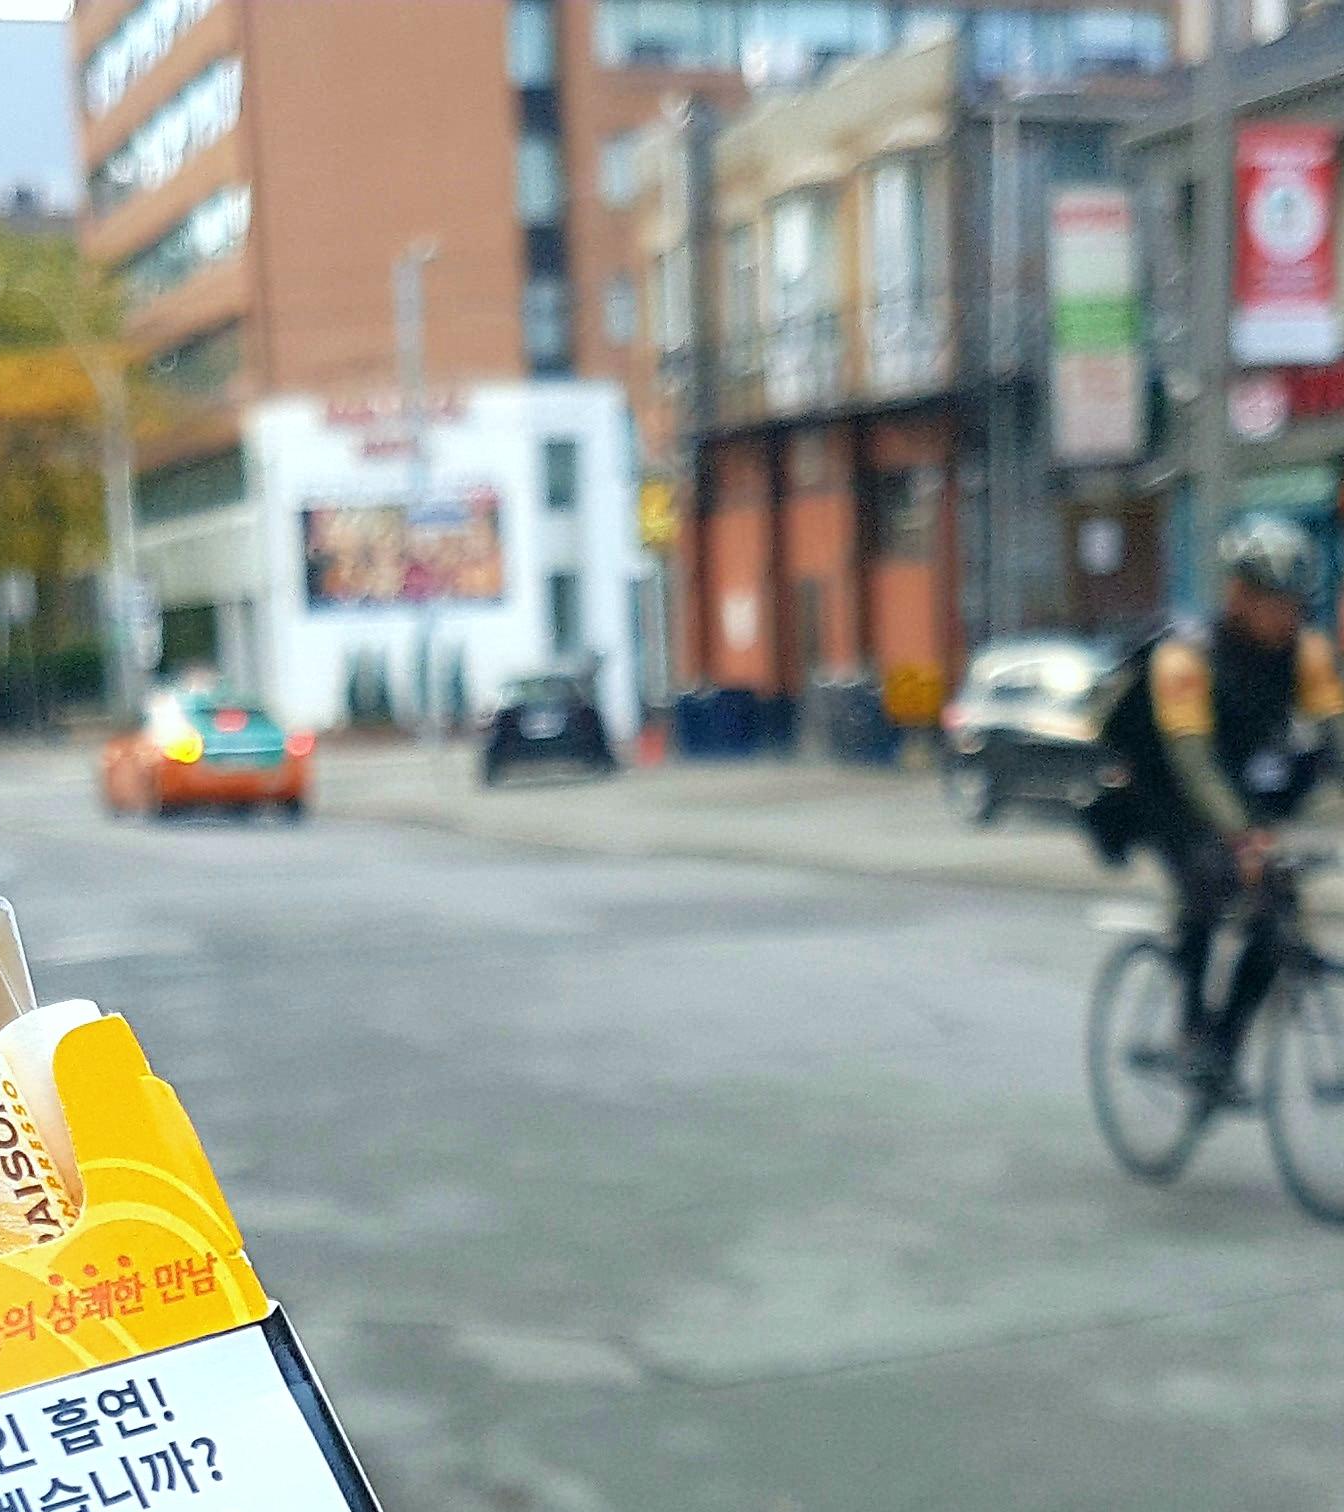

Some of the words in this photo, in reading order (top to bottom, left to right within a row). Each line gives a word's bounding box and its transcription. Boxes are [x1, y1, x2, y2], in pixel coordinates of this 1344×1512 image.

[46, 1269, 145, 1335] 상쾌한
[155, 1251, 218, 1306] 만남
[41, 1377, 176, 1457] 흡연!
